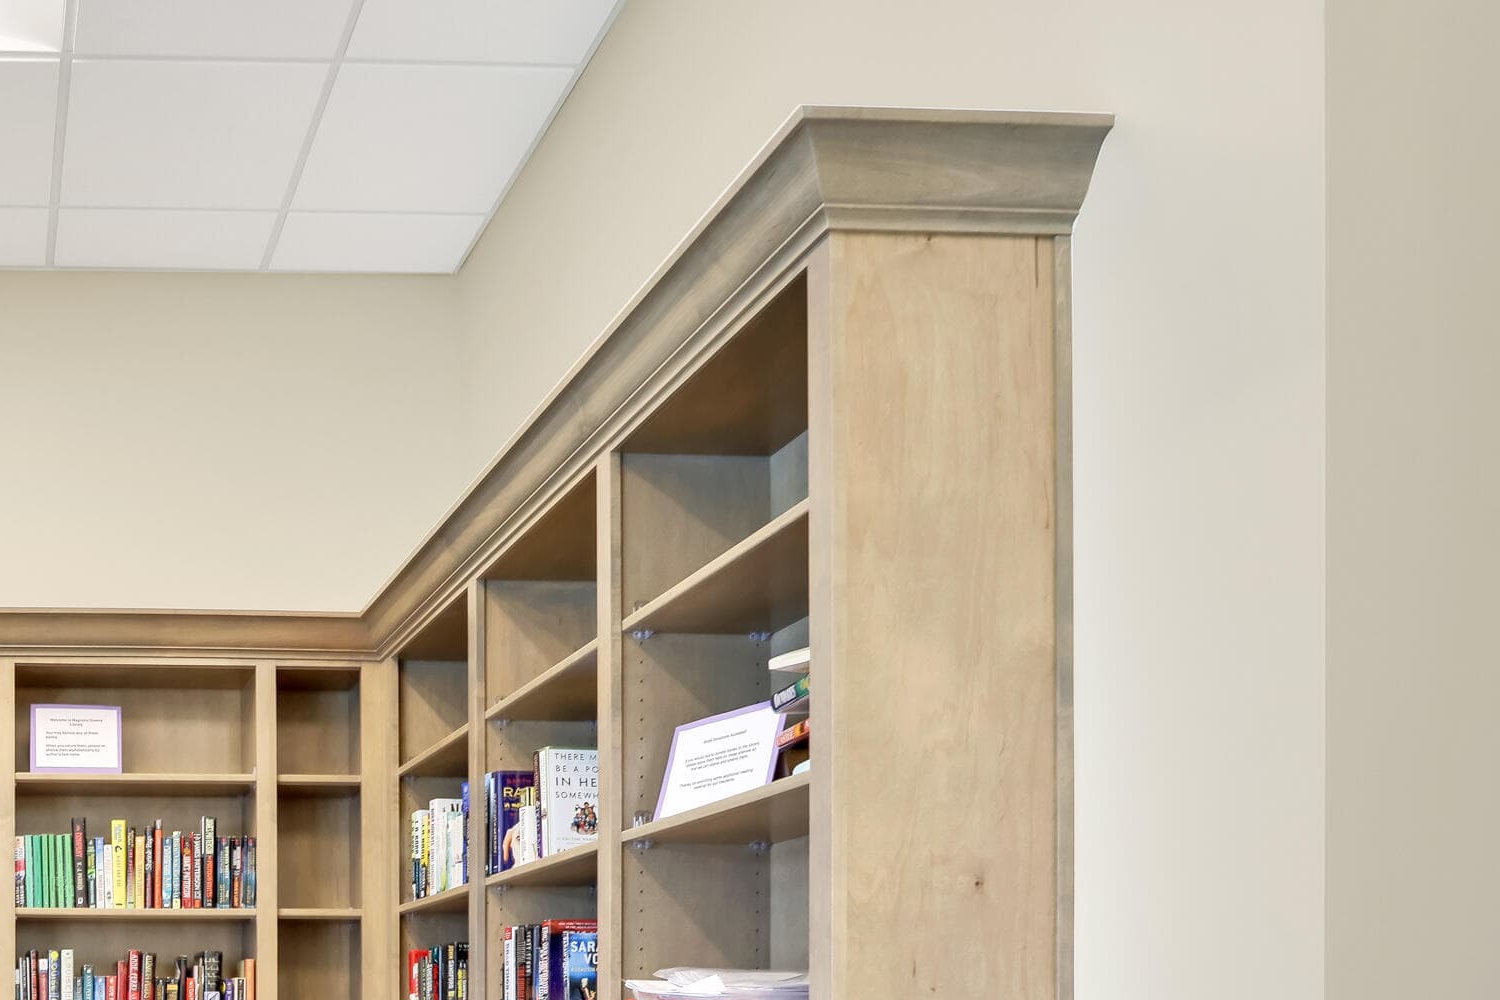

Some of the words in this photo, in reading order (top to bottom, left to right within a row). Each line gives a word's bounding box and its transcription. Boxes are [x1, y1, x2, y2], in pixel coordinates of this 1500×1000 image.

[554, 753, 585, 761] THERE
[556, 778, 571, 786] IN
[579, 778, 598, 786] HE
[555, 791, 598, 799] SOMEWH
[75, 832, 83, 858] COMPANY
[570, 941, 598, 953] SARA
